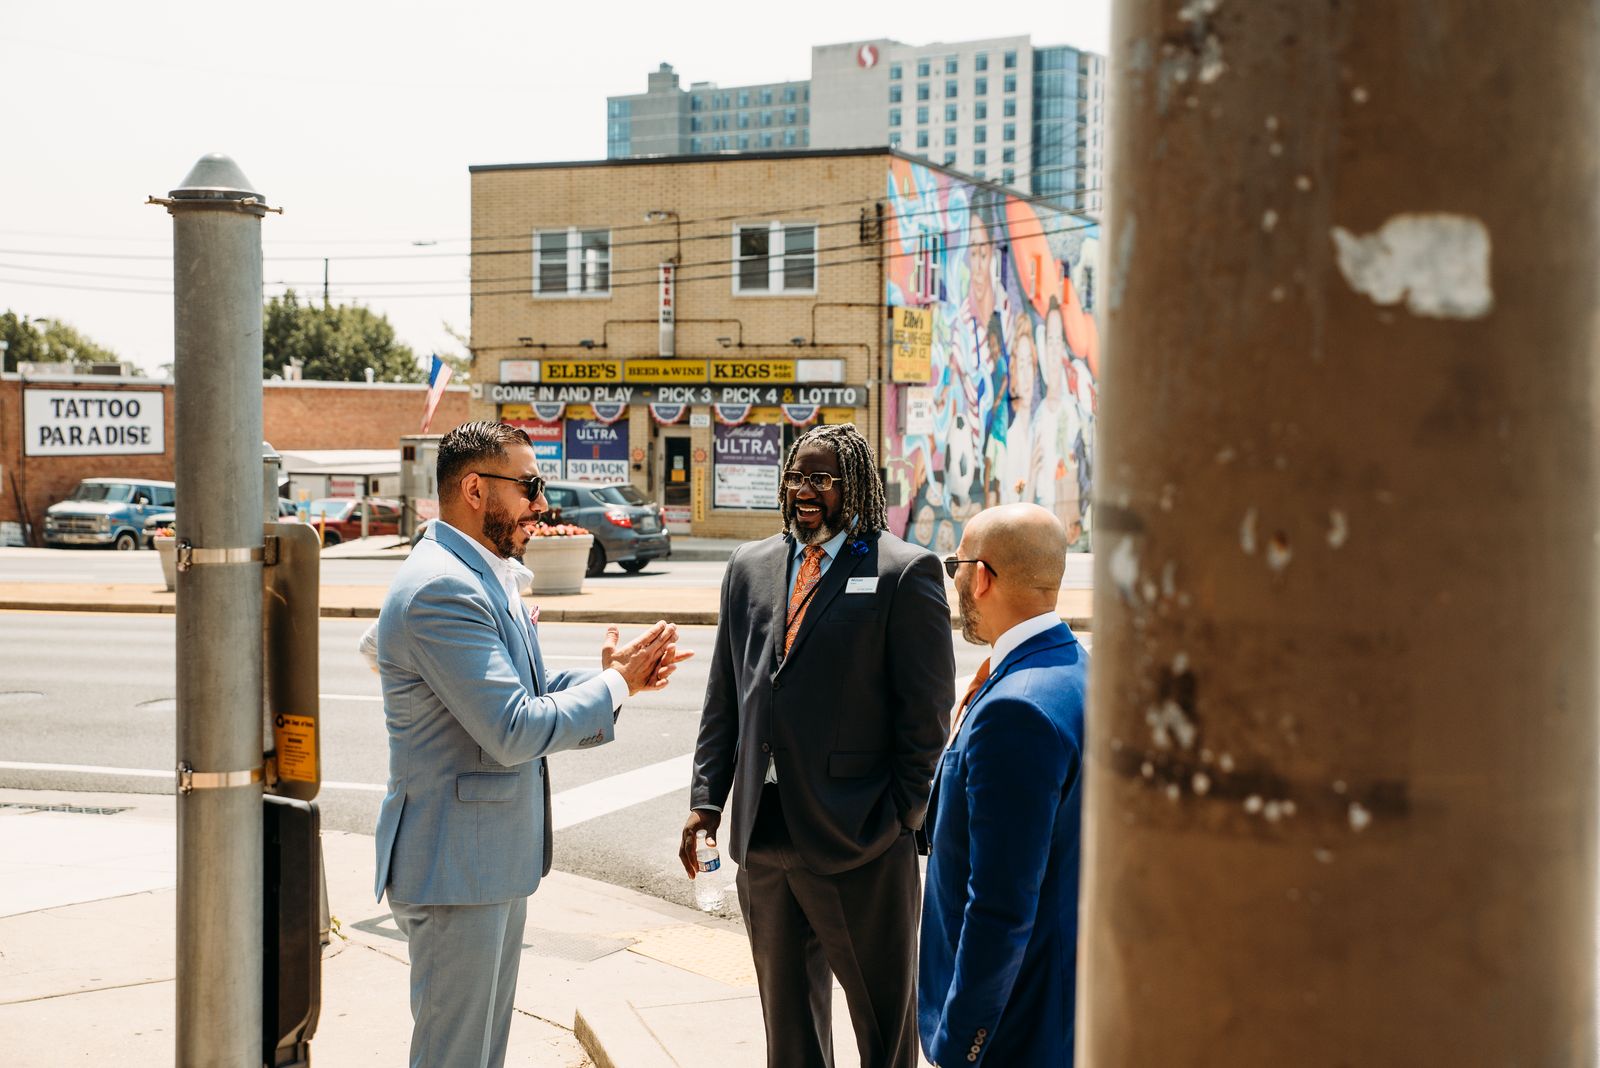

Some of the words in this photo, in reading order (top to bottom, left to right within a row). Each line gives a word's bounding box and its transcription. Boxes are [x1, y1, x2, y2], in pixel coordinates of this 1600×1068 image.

[547, 364, 617, 379] ELBE'S
[628, 367, 660, 376] BEER
[662, 367, 670, 376] &
[670, 367, 704, 376] WINE
[714, 364, 770, 378] KEGS
[492, 386, 536, 401] COME
[539, 386, 554, 401] IN
[559, 387, 591, 401] AND
[594, 387, 634, 402] PLAY
[658, 387, 695, 402] PICK
[700, 388, 712, 402] 3
[722, 388, 761, 403] PICK
[765, 388, 778, 403] 4
[782, 388, 795, 403] &
[799, 388, 857, 404] LOTTO
[51, 398, 140, 418] TATTOO
[39, 426, 151, 446] PARADISE
[576, 428, 618, 440] ULTRA
[716, 438, 776, 455] ULTRA
[537, 463, 558, 473] CK
[571, 462, 587, 474] 30
[591, 462, 625, 474] PACK
